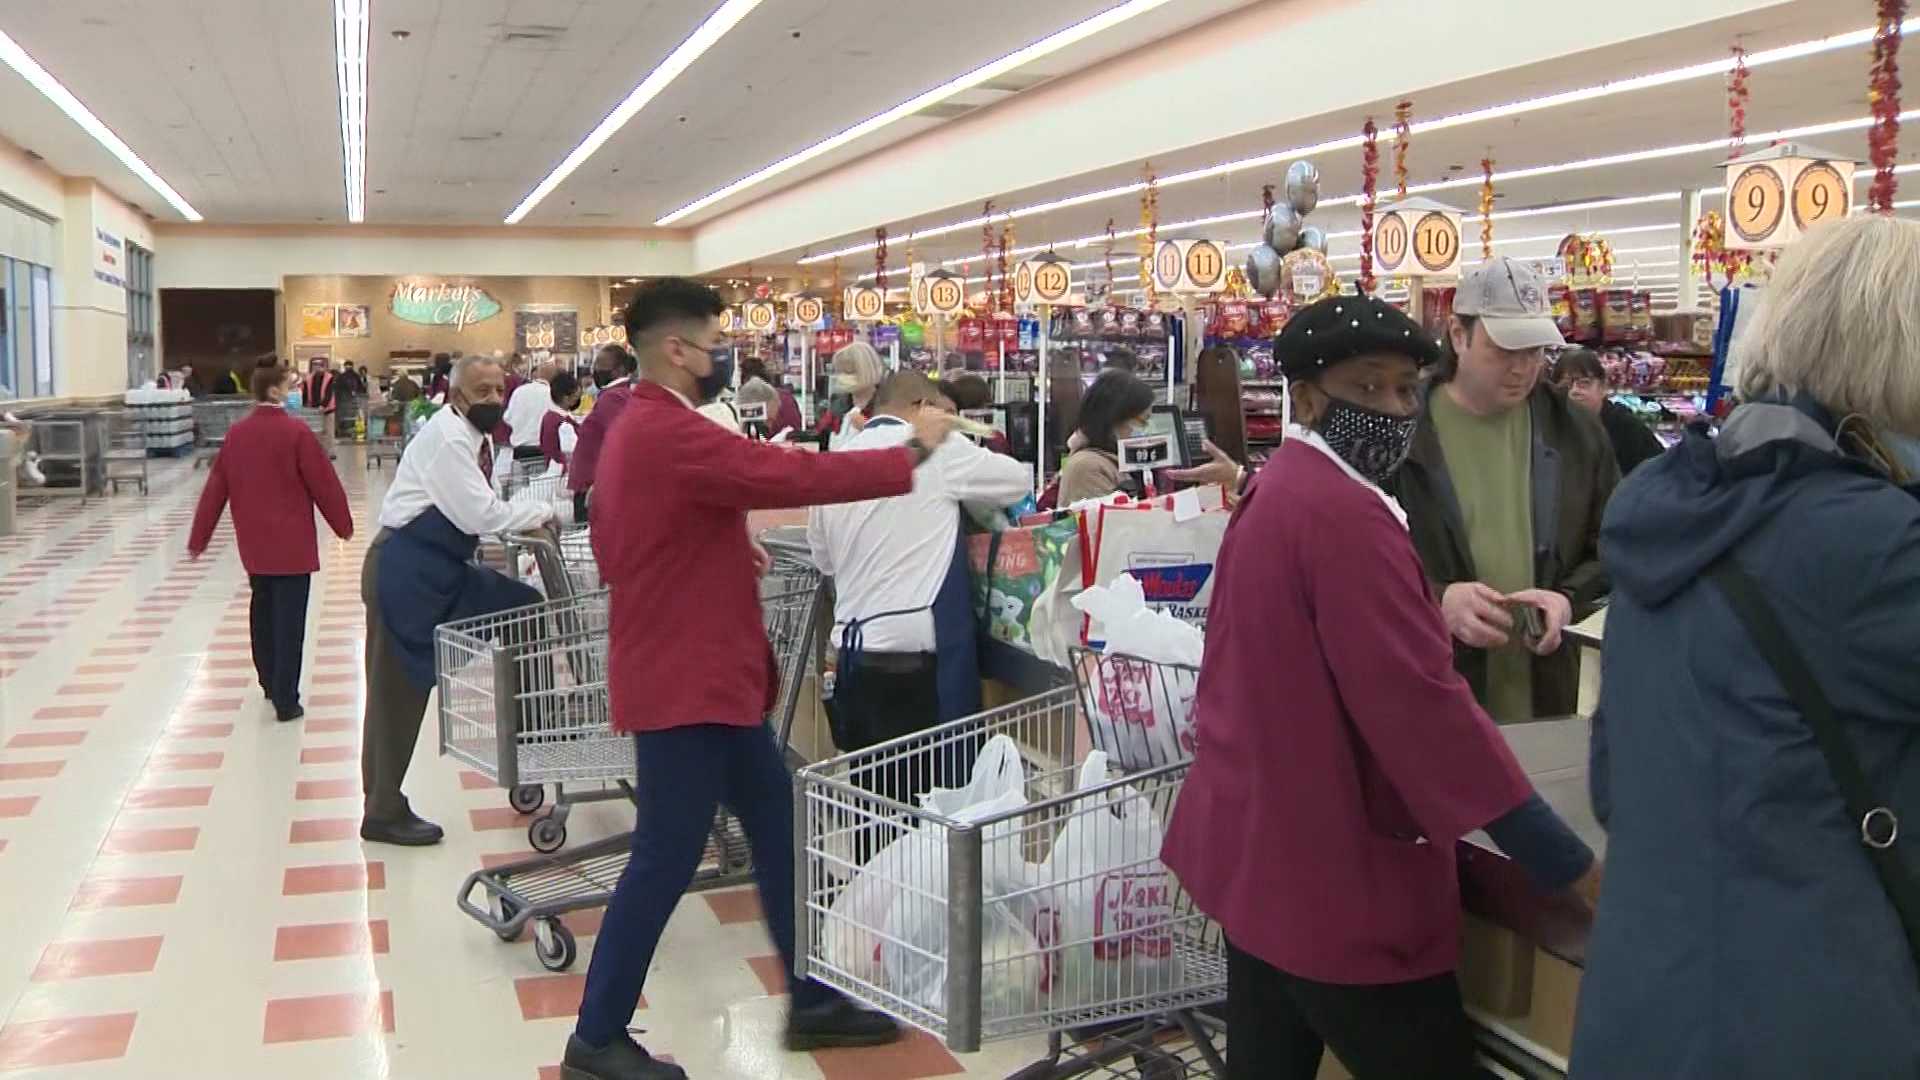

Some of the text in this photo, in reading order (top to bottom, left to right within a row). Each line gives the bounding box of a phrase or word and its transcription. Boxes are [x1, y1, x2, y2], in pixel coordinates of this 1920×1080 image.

[1743, 184, 1765, 223] 9
[1807, 183, 1829, 221] 9
[1382, 226, 1401, 255] 10
[1424, 227, 1450, 256] 10
[1193, 253, 1213, 276] 11
[1042, 272, 1062, 291] 12
[861, 295, 876, 309] 14
[936, 286, 955, 303] 13
[755, 310, 768, 321] 16
[802, 304, 817, 317] 15
